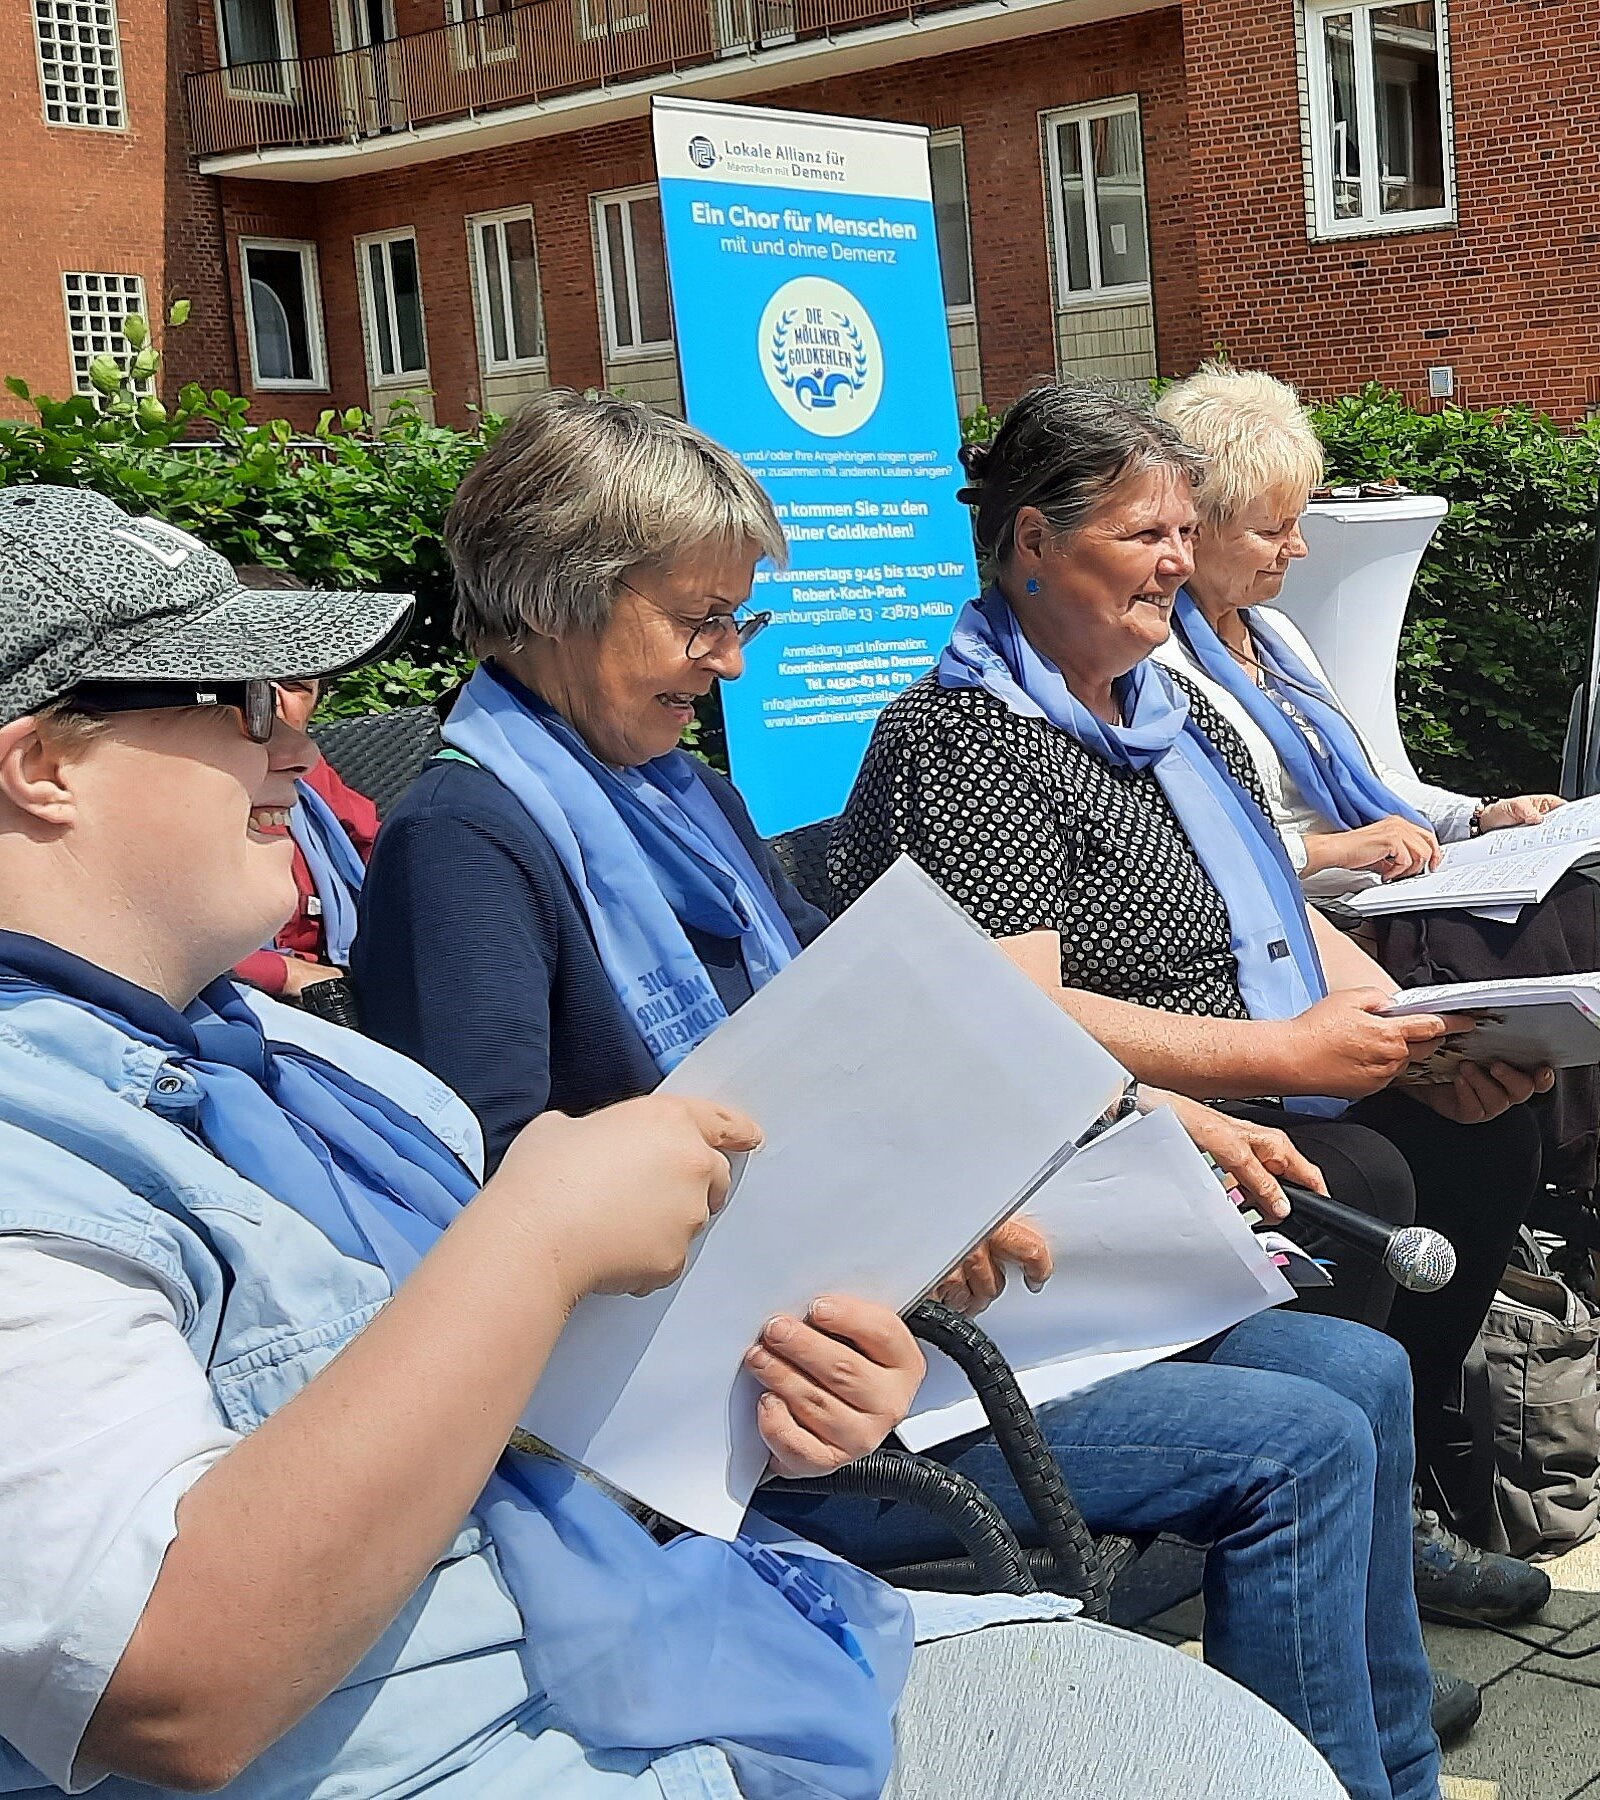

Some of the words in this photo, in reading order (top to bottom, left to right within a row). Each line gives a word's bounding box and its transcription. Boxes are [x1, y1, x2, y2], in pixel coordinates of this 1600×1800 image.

[724, 140, 772, 159] Lokale
[775, 145, 822, 164] Allianz
[825, 149, 845, 166] für
[726, 161, 773, 175] Menschen
[774, 166, 789, 176] mit
[791, 163, 846, 182] Demenz
[690, 201, 725, 225] Ein
[728, 205, 780, 230] Chor
[782, 208, 812, 232] für
[815, 212, 917, 240] Menschen
[720, 235, 748, 254] mit
[752, 238, 785, 256] und
[788, 238, 828, 259] ohne
[831, 242, 897, 264] Demenz
[805, 307, 824, 325] DIE
[794, 324, 841, 347] MÖLLNER
[788, 347, 853, 369] GOLDKEHLEN
[814, 449, 876, 466] Angehörigen
[909, 451, 938, 468] gern?
[768, 467, 821, 478] zusammen
[838, 466, 880, 478] anderen
[880, 466, 912, 478] Leuten
[912, 465, 954, 480] singen?
[790, 500, 853, 518] kommen
[855, 501, 879, 518] Sie
[881, 502, 899, 517] zu
[900, 500, 929, 517] den
[781, 523, 826, 542] öllner
[826, 521, 915, 541] Goldkehlen!
[853, 567, 883, 583] 9:45
[883, 563, 905, 580] bis
[905, 564, 936, 582] 11:30
[937, 561, 966, 578] Uhr
[791, 584, 908, 603] Robert-Koch-Park
[858, 606, 873, 623] 13
[880, 604, 920, 621] 23879
[920, 601, 954, 619] Mölln
[782, 643, 844, 659] Anmeldung
[844, 641, 865, 656] und
[778, 656, 891, 676] Koordinierungsstelle
[890, 654, 936, 668] Demenz
